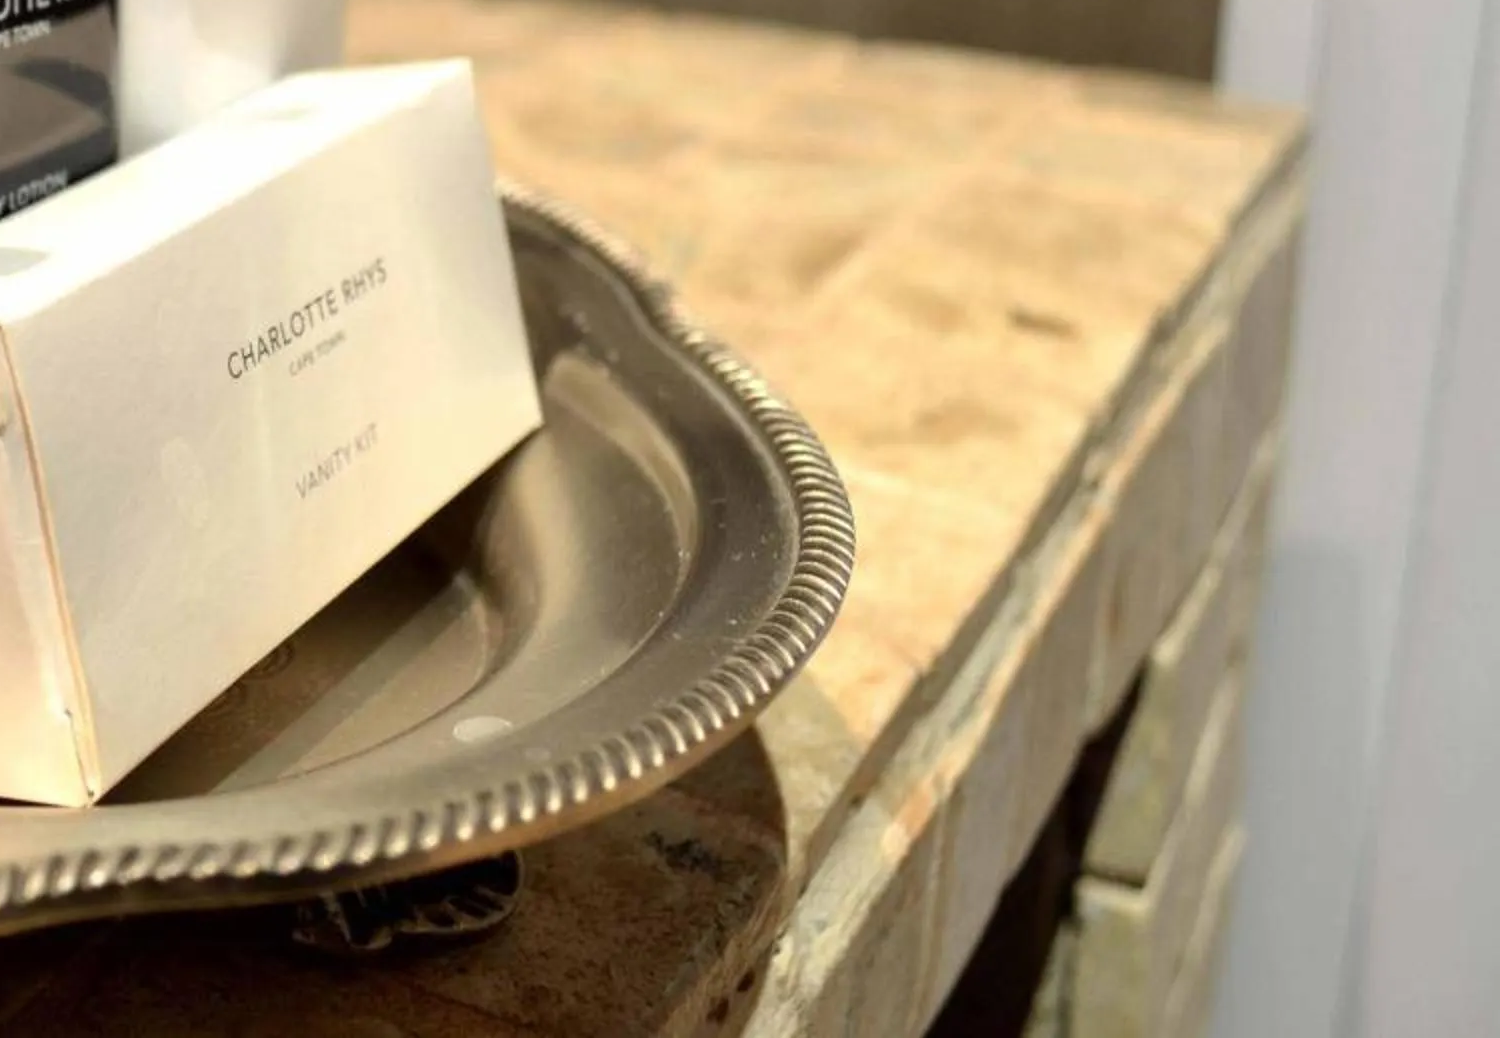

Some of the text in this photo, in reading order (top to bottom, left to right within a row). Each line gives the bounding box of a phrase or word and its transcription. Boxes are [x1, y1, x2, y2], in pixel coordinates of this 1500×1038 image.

[12, 19, 51, 43] TOWN
[9, 169, 68, 212] LOTION
[227, 258, 388, 379] CHARLOTTE RHYS
[295, 422, 379, 499] VANITY KIT
